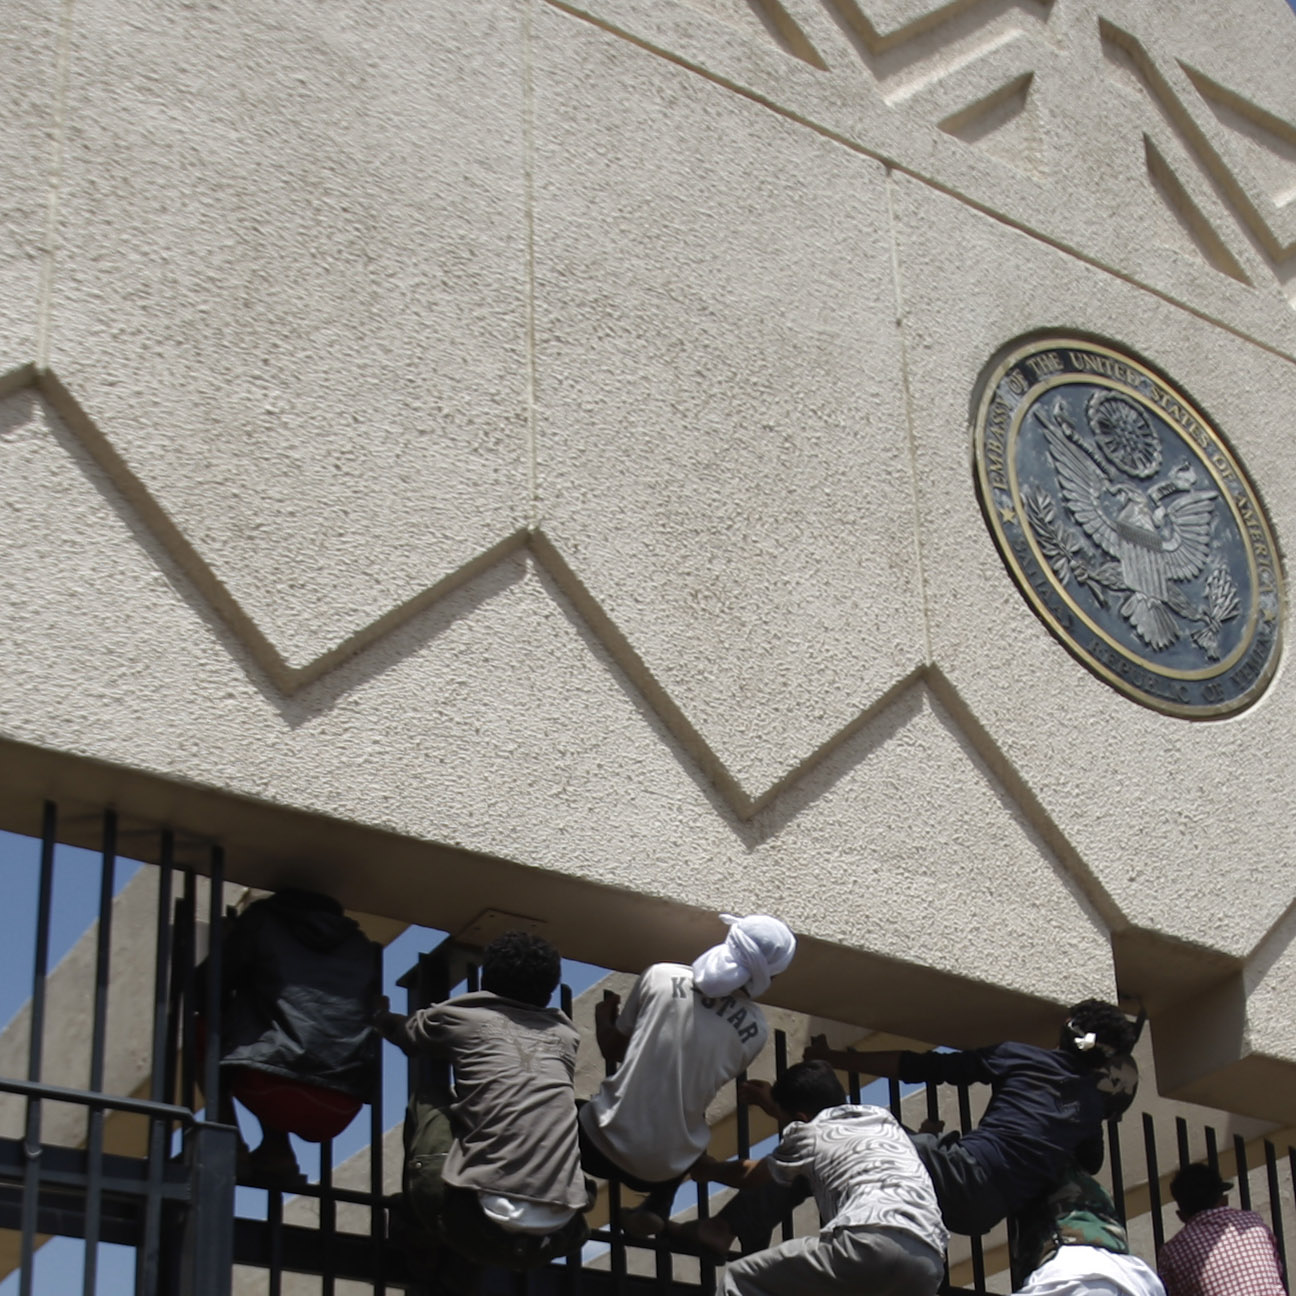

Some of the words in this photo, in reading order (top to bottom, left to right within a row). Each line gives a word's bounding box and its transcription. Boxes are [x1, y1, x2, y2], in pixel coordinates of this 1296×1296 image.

[987, 400, 1012, 490] EMBASSY
[1008, 369, 1030, 396] OF
[1026, 352, 1064, 376] THE
[1068, 352, 1143, 387] UNITED
[1151, 386, 1211, 448] STATES
[1211, 454, 1236, 482] OF
[1236, 494, 1275, 594] AMERICA
